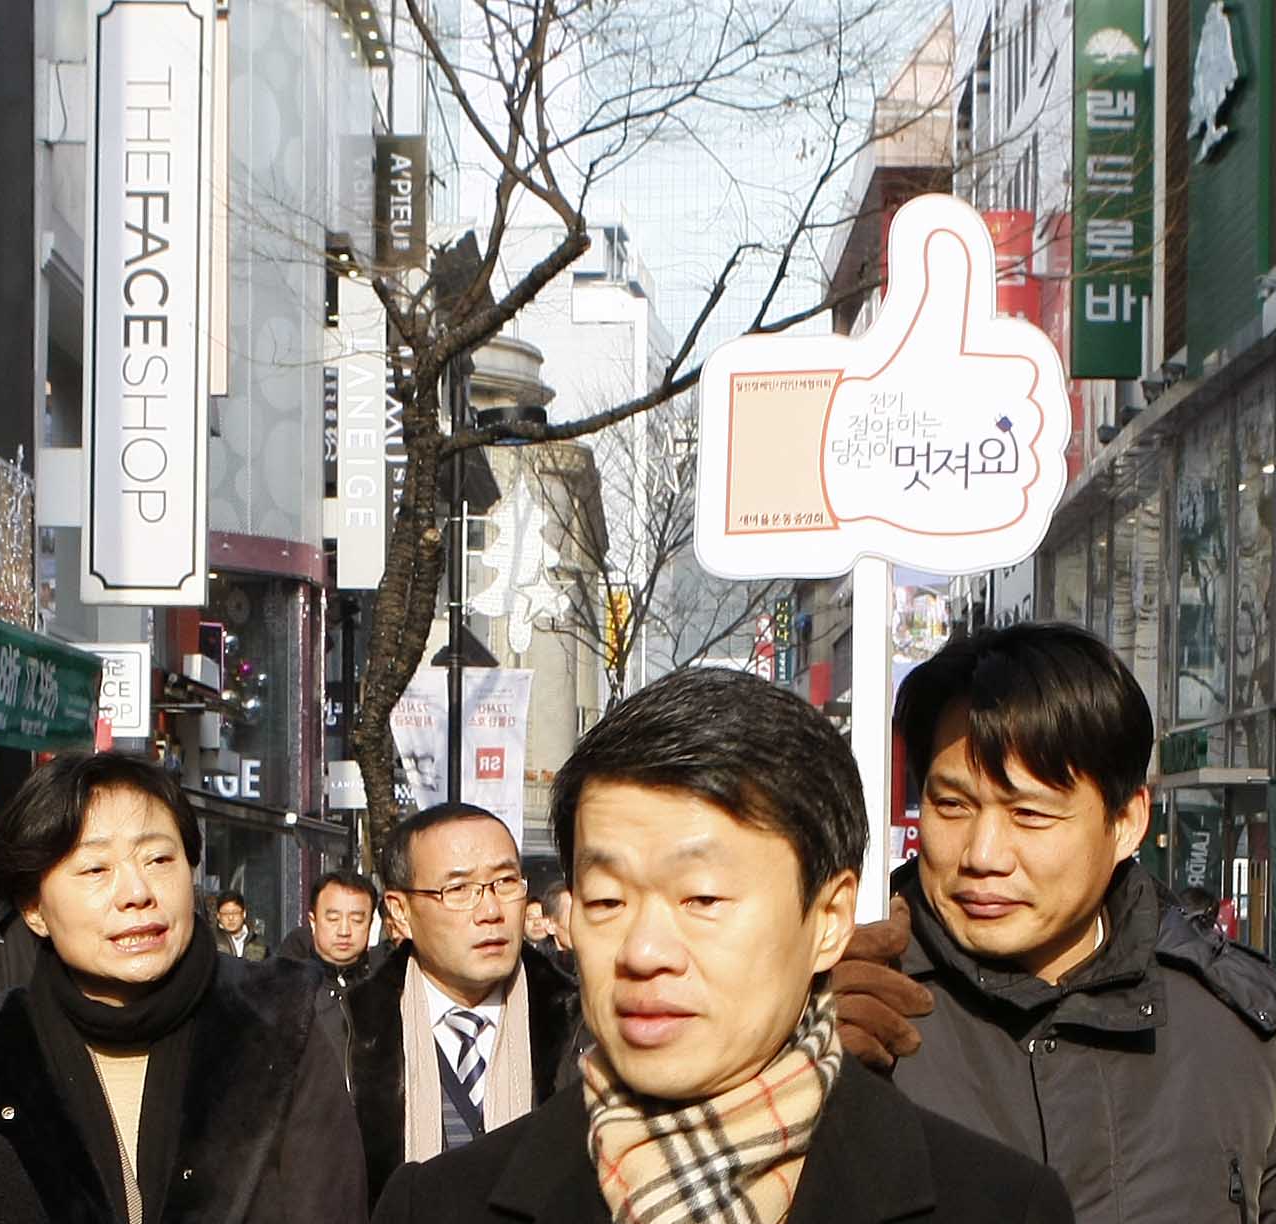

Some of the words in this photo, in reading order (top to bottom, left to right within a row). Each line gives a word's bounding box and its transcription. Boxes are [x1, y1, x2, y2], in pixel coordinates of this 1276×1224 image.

[1085, 89, 1137, 323] 랜드로바
[848, 410, 942, 441] 절약하는
[895, 438, 1018, 491] 멋져요
